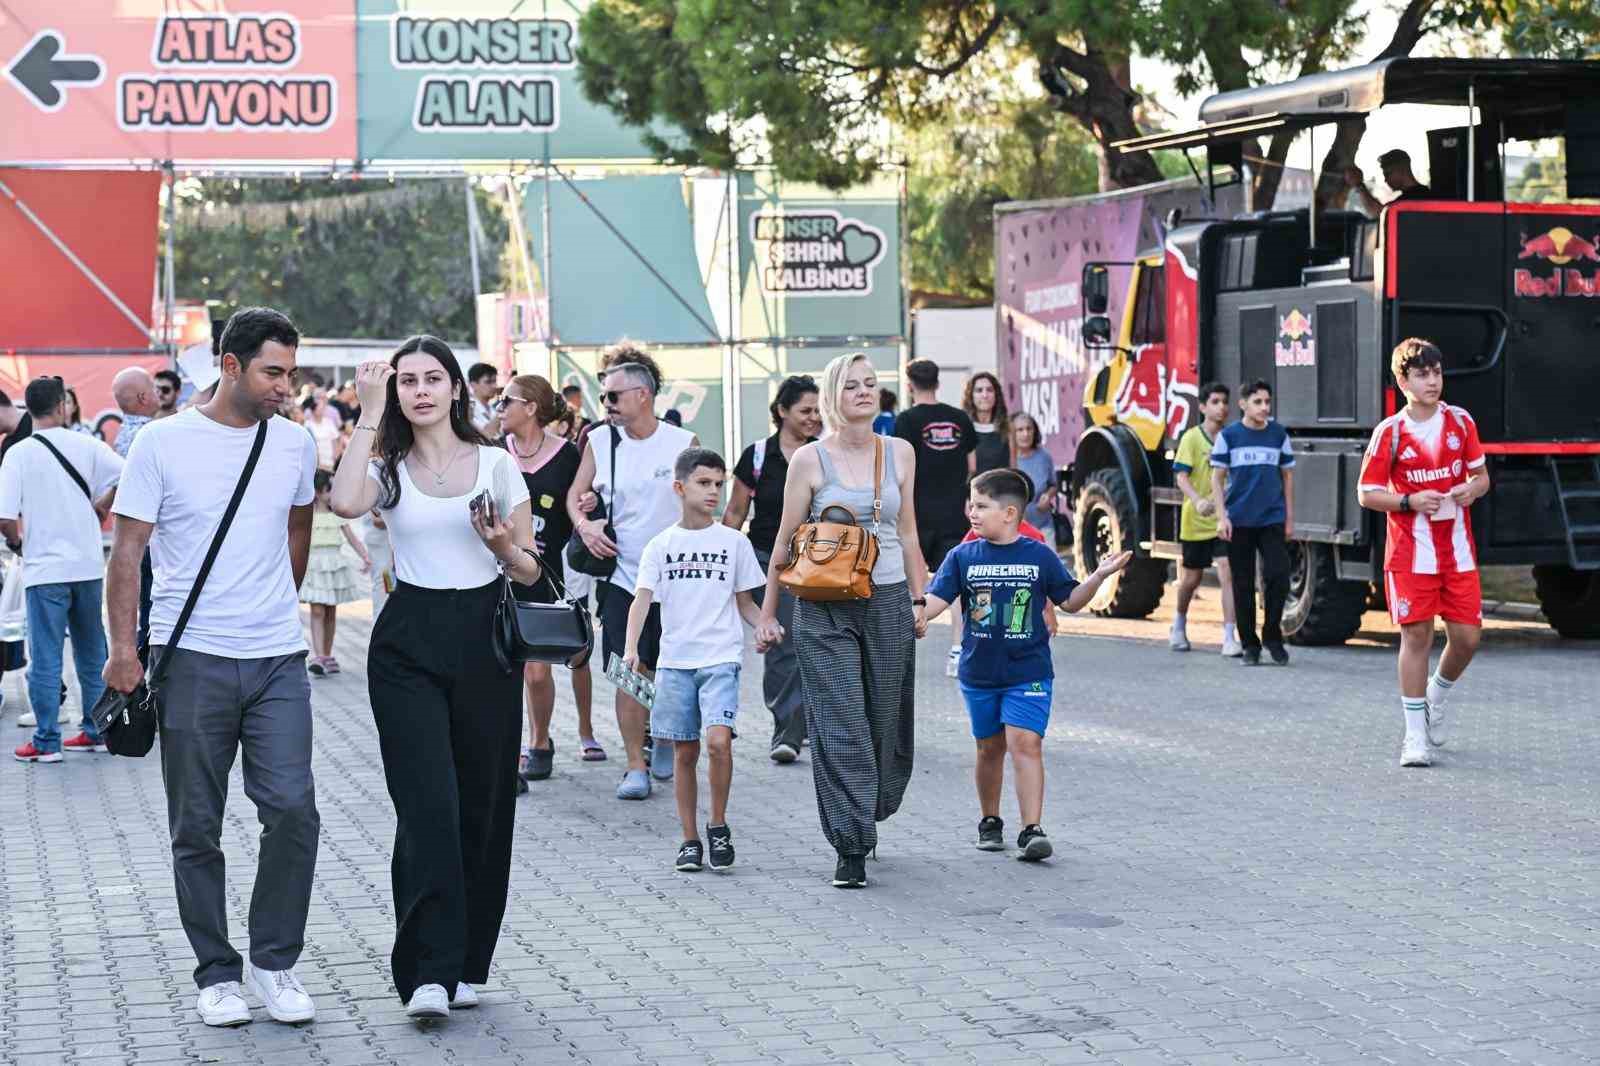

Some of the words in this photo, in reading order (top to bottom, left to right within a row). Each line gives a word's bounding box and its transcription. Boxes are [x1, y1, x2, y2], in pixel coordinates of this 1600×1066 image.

[158, 18, 296, 63] ATLAS
[397, 17, 573, 64] KONSER
[123, 80, 331, 126] PAVYONU
[419, 80, 554, 126] ALANI
[756, 216, 837, 240] KONSER
[769, 236, 844, 268] ŞEHRİN
[766, 262, 867, 290] KALBİNDE
[1514, 267, 1562, 297] Red
[1564, 267, 1600, 297] Bul
[1406, 466, 1451, 483] Allianz
[966, 564, 1040, 582] MINECRAFT
